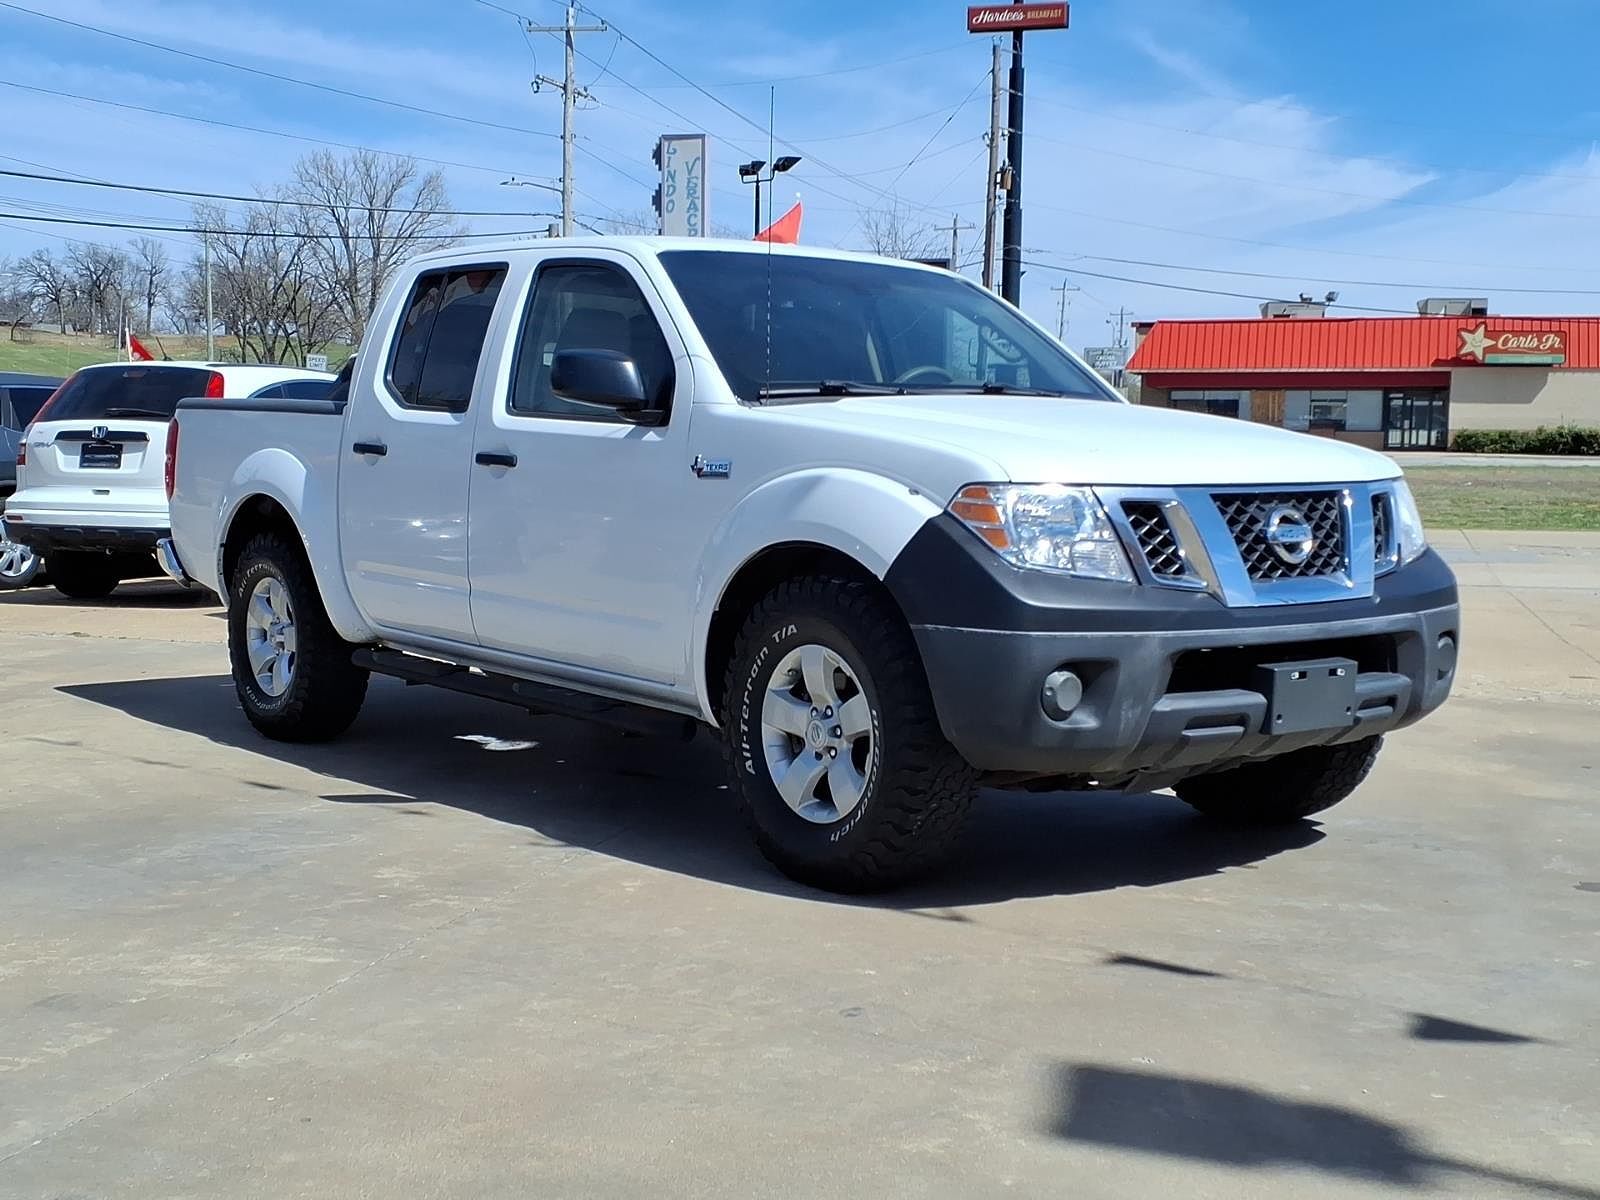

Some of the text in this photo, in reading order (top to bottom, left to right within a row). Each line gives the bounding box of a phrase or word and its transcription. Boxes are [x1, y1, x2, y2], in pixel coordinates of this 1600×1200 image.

[1027, 9, 1062, 19] BREAKFAST
[665, 141, 677, 213] LINDO
[1498, 333, 1538, 349] Carl's
[705, 463, 729, 472] TEXAS
[772, 624, 797, 643] T/A
